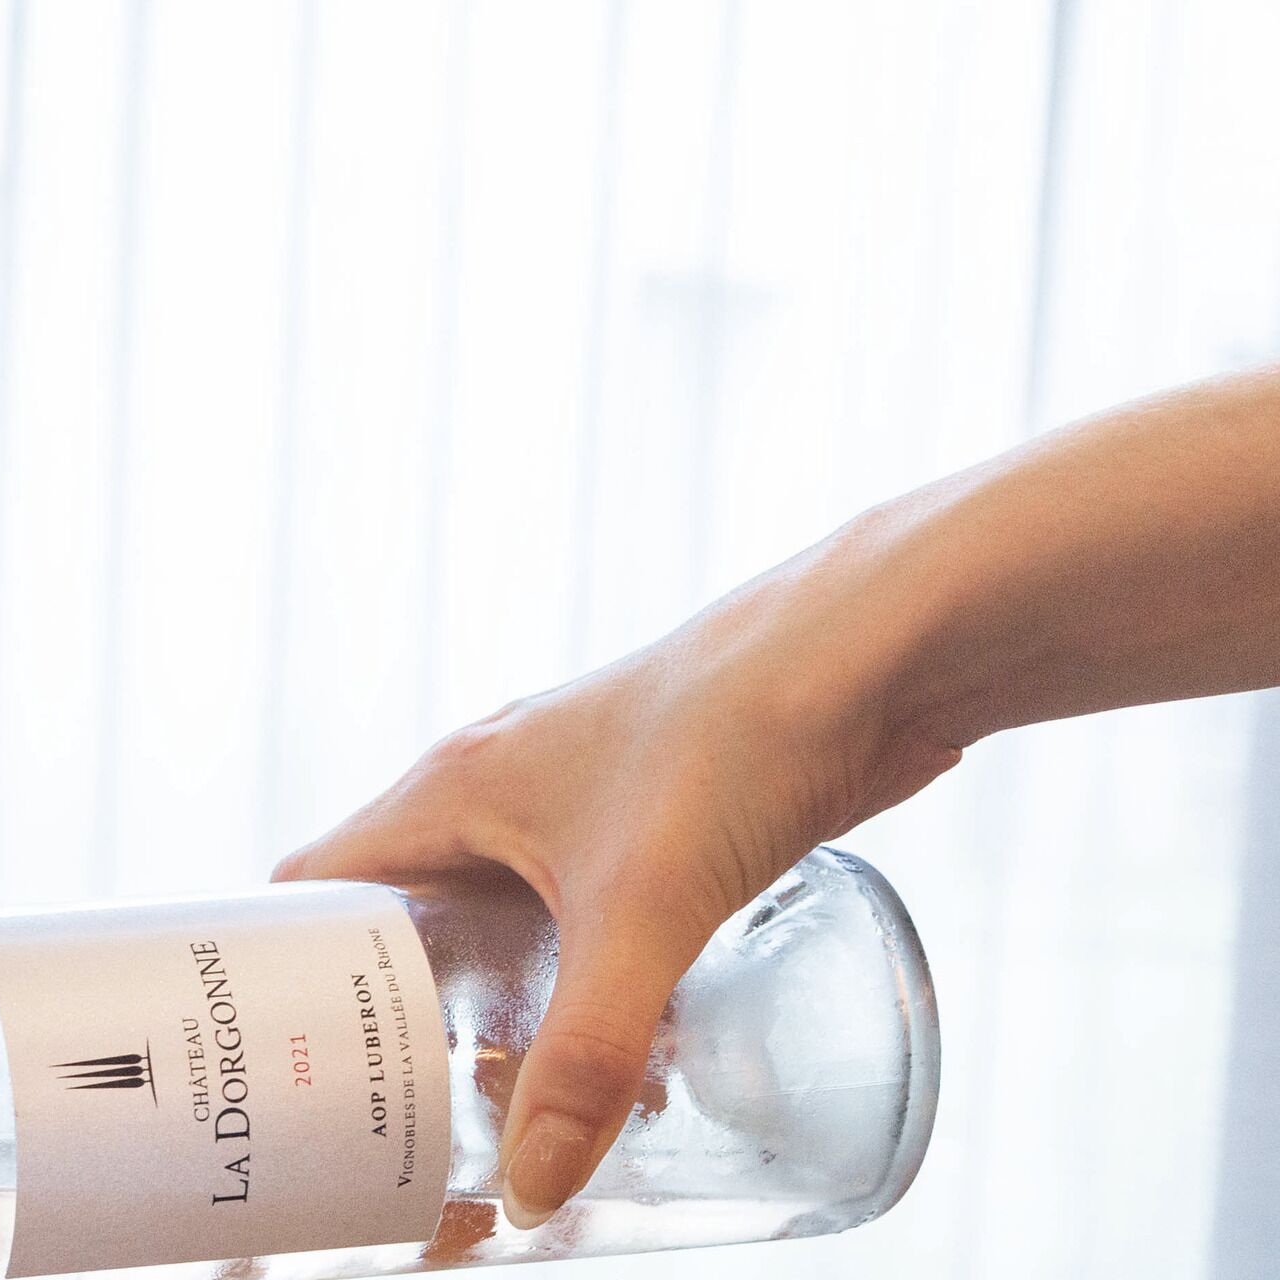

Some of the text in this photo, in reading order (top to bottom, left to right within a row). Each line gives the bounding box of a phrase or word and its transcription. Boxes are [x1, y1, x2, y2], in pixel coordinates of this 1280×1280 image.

[385, 973, 400, 992] DU
[390, 995, 411, 1051] VALLÉE
[182, 1018, 210, 1122] CHÂTEAU
[190, 940, 251, 1207] LA DORGONNE
[290, 1033, 313, 1087] 2021
[351, 973, 387, 1138] AOP LUBERON
[401, 1055, 414, 1075] LA
[403, 1079, 416, 1099] DE
[397, 1102, 416, 1188] VIGNOBLES
